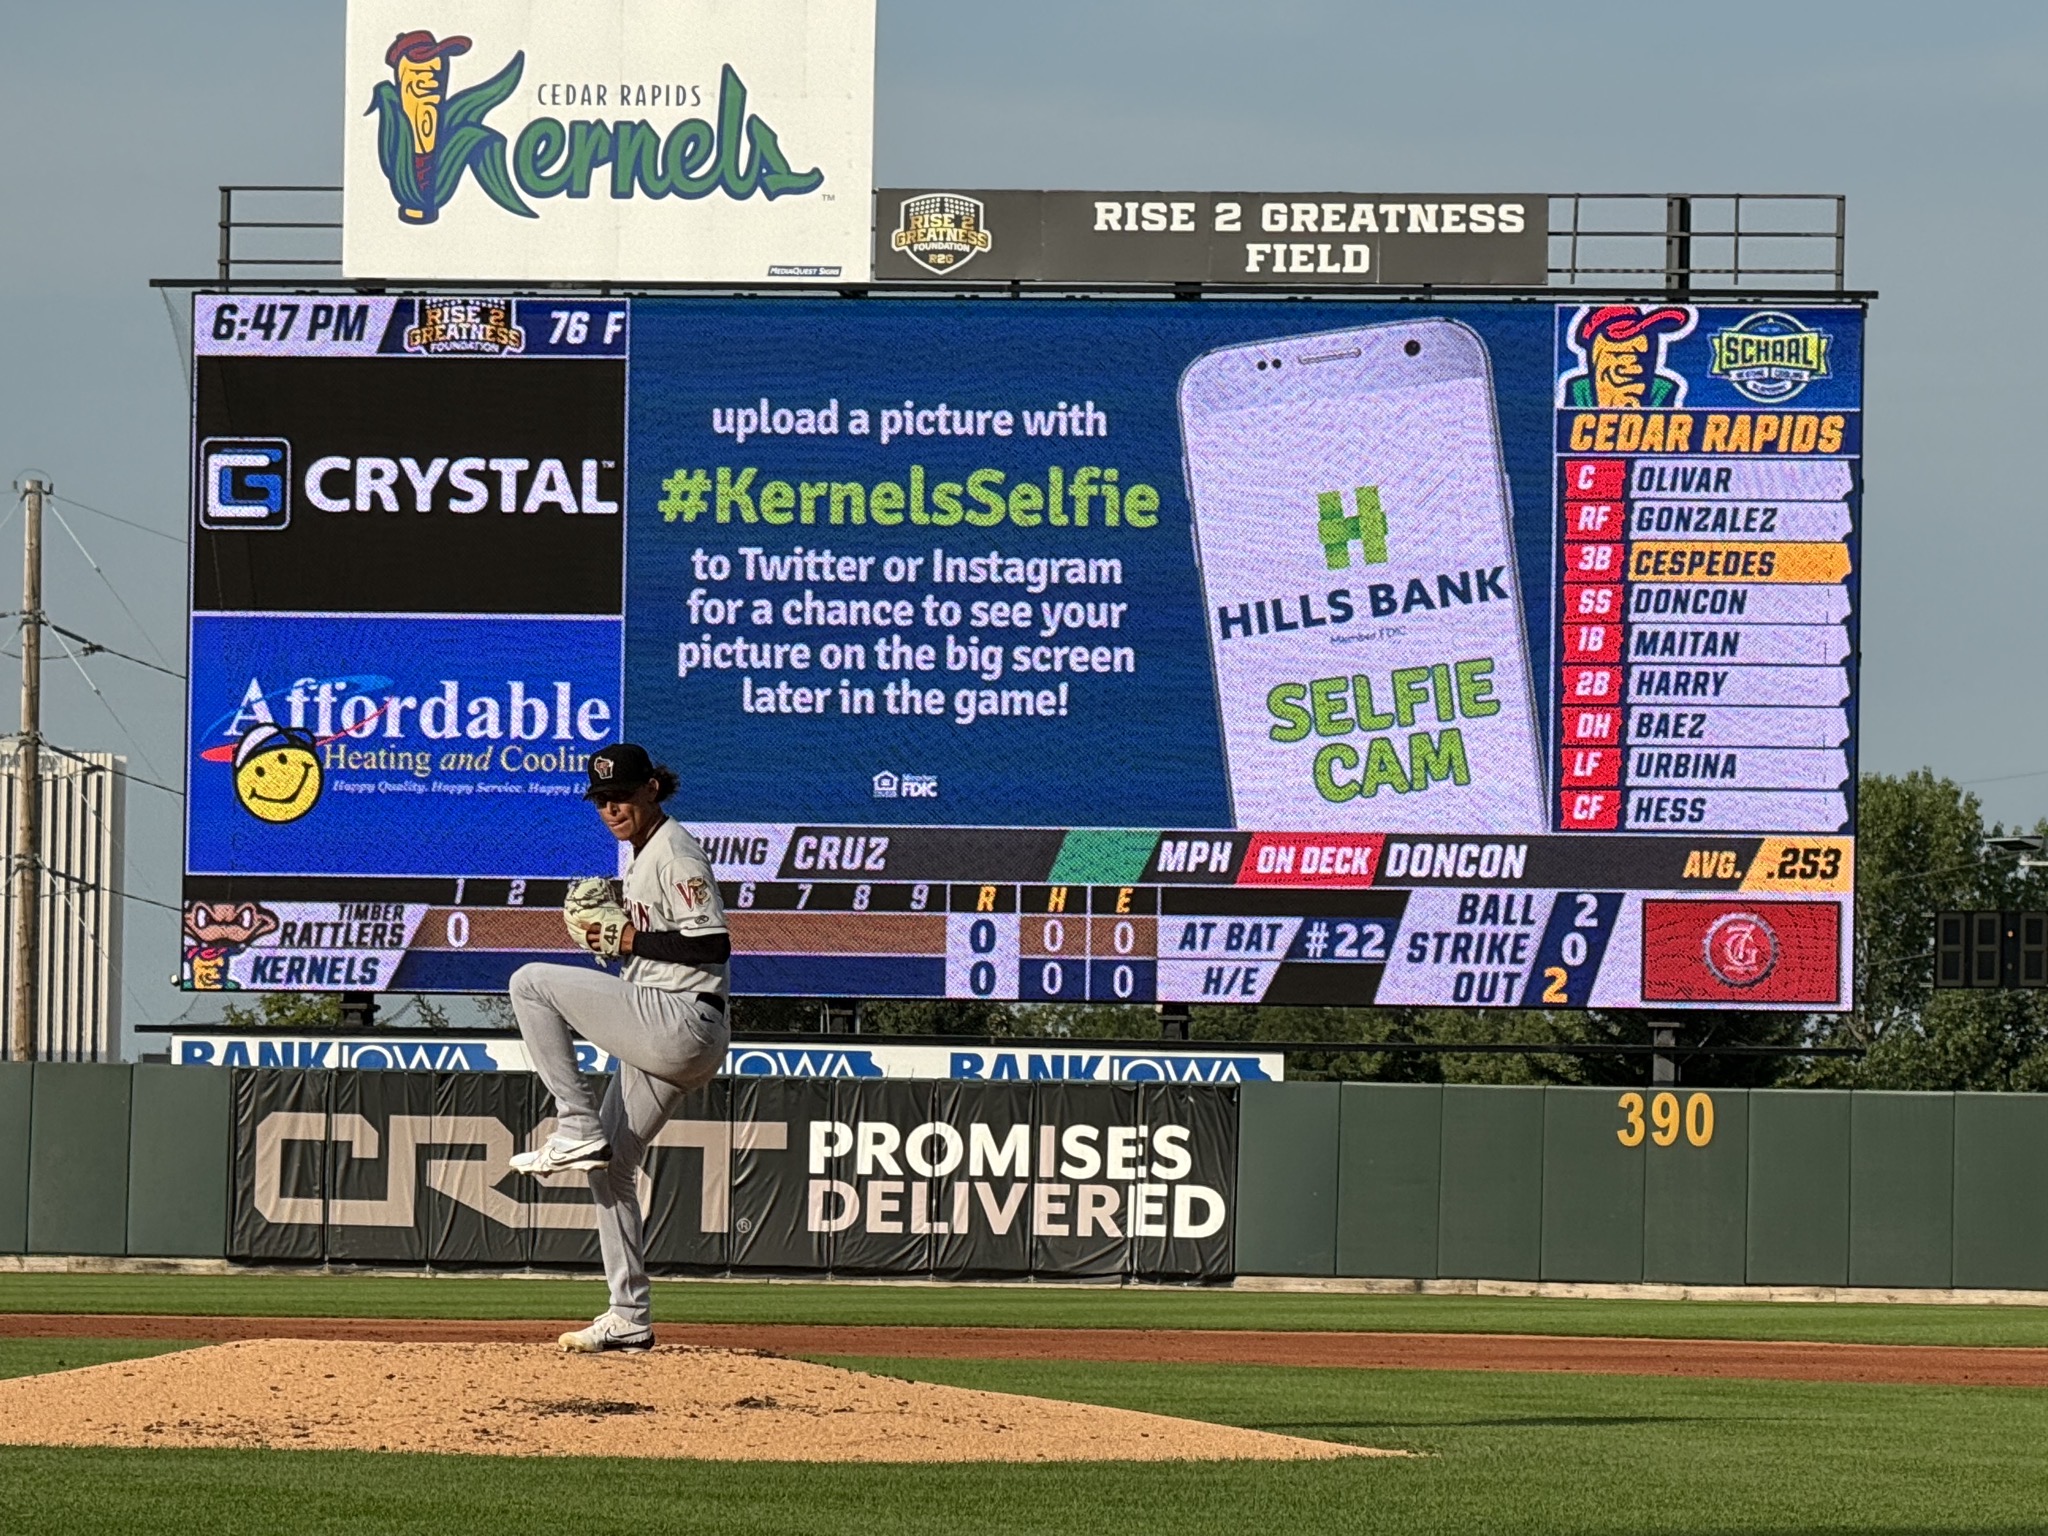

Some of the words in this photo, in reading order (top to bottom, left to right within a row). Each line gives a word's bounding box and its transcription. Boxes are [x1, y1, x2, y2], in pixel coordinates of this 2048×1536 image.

[538, 83, 608, 106] CEDAR
[620, 84, 702, 107] RAPIDS
[363, 30, 824, 225] Kernels
[910, 213, 955, 230] RISE
[961, 215, 975, 230] 2
[1094, 201, 1194, 232] RISE
[1214, 202, 1242, 232] 2
[1261, 203, 1525, 234] GREATNESS
[895, 227, 988, 248] GREATNESS
[913, 241, 971, 253] FOUNDATION
[928, 253, 954, 264] R2G
[1245, 243, 1371, 273] FIELD
[212, 303, 301, 341] 6:47
[307, 305, 369, 342] PM
[425, 305, 481, 325] RISE
[489, 308, 505, 327] 2
[549, 311, 590, 345] 76
[604, 311, 625, 344] F
[409, 323, 521, 348] GREATNESS
[430, 341, 500, 353] FOUNDATION
[1726, 336, 1814, 365] SCHAAL
[712, 398, 839, 443] upload
[848, 409, 871, 435] a
[880, 401, 1013, 444] picture
[1022, 402, 1107, 437] with
[1569, 413, 1694, 452] CEDAR
[1701, 414, 1846, 453] RAPIDS
[304, 456, 619, 514] CRYSTAL
[1577, 465, 1597, 490] C
[1637, 467, 1733, 493] OLIVAR
[657, 464, 1161, 528] #KernelsSelfie
[1317, 485, 1389, 570] H
[1577, 506, 1611, 531] RF
[1636, 507, 1778, 533] GONZALEZ
[691, 549, 730, 582] to
[739, 547, 875, 583] Twitter
[883, 556, 923, 584] or
[933, 549, 1122, 593] Instagram
[1578, 543, 1612, 570] 3B
[1634, 550, 1776, 577] CESPEDES
[686, 589, 743, 625] for
[751, 598, 773, 626] a
[782, 590, 913, 627] chance
[922, 595, 962, 628] to
[970, 601, 1032, 628] see
[1039, 600, 1127, 636] your
[1218, 588, 1357, 640] HILLS
[1369, 566, 1510, 620] BANK
[1578, 588, 1613, 614] SS
[1634, 588, 1748, 615] DONCON
[677, 635, 810, 676] picture
[819, 643, 866, 670] on
[874, 636, 935, 671] the
[946, 638, 1002, 680] big
[1012, 645, 1135, 673] screen
[1577, 626, 1605, 651] 1B
[1634, 630, 1741, 657] MAITAN
[1575, 671, 1610, 696] 2B
[1635, 671, 1729, 696] HARRY
[223, 676, 611, 742] Affordable
[742, 677, 832, 714] later
[838, 679, 874, 715] in
[883, 680, 945, 715] the
[954, 682, 1070, 724] game!
[1266, 657, 1501, 744] SELFIE
[1576, 713, 1612, 739] DH
[1635, 713, 1707, 739] BAEZ
[325, 744, 431, 777] Heating
[440, 745, 493, 771] and
[500, 745, 588, 773] Coolin
[1312, 728, 1471, 803] CAM
[1573, 752, 1601, 777] LF
[1635, 753, 1738, 779] URBINA
[901, 781, 938, 797] FDIC
[1573, 794, 1604, 820] CF
[1634, 797, 1707, 823] HESS
[793, 836, 890, 871] CRUZ
[1157, 840, 1233, 873] MPH
[1255, 845, 1300, 875] ON
[1302, 846, 1372, 876] DECK
[1384, 843, 1529, 879] DONCON
[1682, 850, 1743, 880] AVG.
[1766, 848, 1842, 880] .253
[455, 878, 465, 904] 1
[507, 879, 527, 905] 2
[738, 883, 757, 908] 6
[797, 884, 812, 910] 7
[852, 885, 872, 911] 8
[910, 884, 930, 910] 9
[976, 886, 997, 912] R
[1047, 886, 1068, 913] H
[1115, 887, 1135, 914] E
[337, 904, 405, 923] TIMBER
[1457, 894, 1537, 926] BALL
[1575, 893, 1599, 927] 2
[279, 921, 405, 948] RATTLERS
[447, 911, 470, 948] 0
[969, 919, 997, 949] 0
[1043, 919, 1064, 952] 0
[1113, 921, 1135, 954] 0
[1177, 923, 1219, 951] AT
[1224, 923, 1284, 952] BAT
[1305, 922, 1386, 959] #22
[1406, 932, 1532, 965] STRIKE
[1561, 932, 1588, 967] 0
[250, 954, 380, 986] KERNELS
[969, 960, 997, 995] 0
[1042, 961, 1063, 996] 0
[1112, 964, 1134, 998] 0
[1203, 966, 1260, 996] H/E
[1453, 971, 1523, 1003] OUT
[1542, 966, 1568, 1004] 2
[1617, 1091, 1716, 1148] 390
[808, 1120, 1193, 1180] PROMISES
[807, 1179, 1227, 1239] DELIVERED
